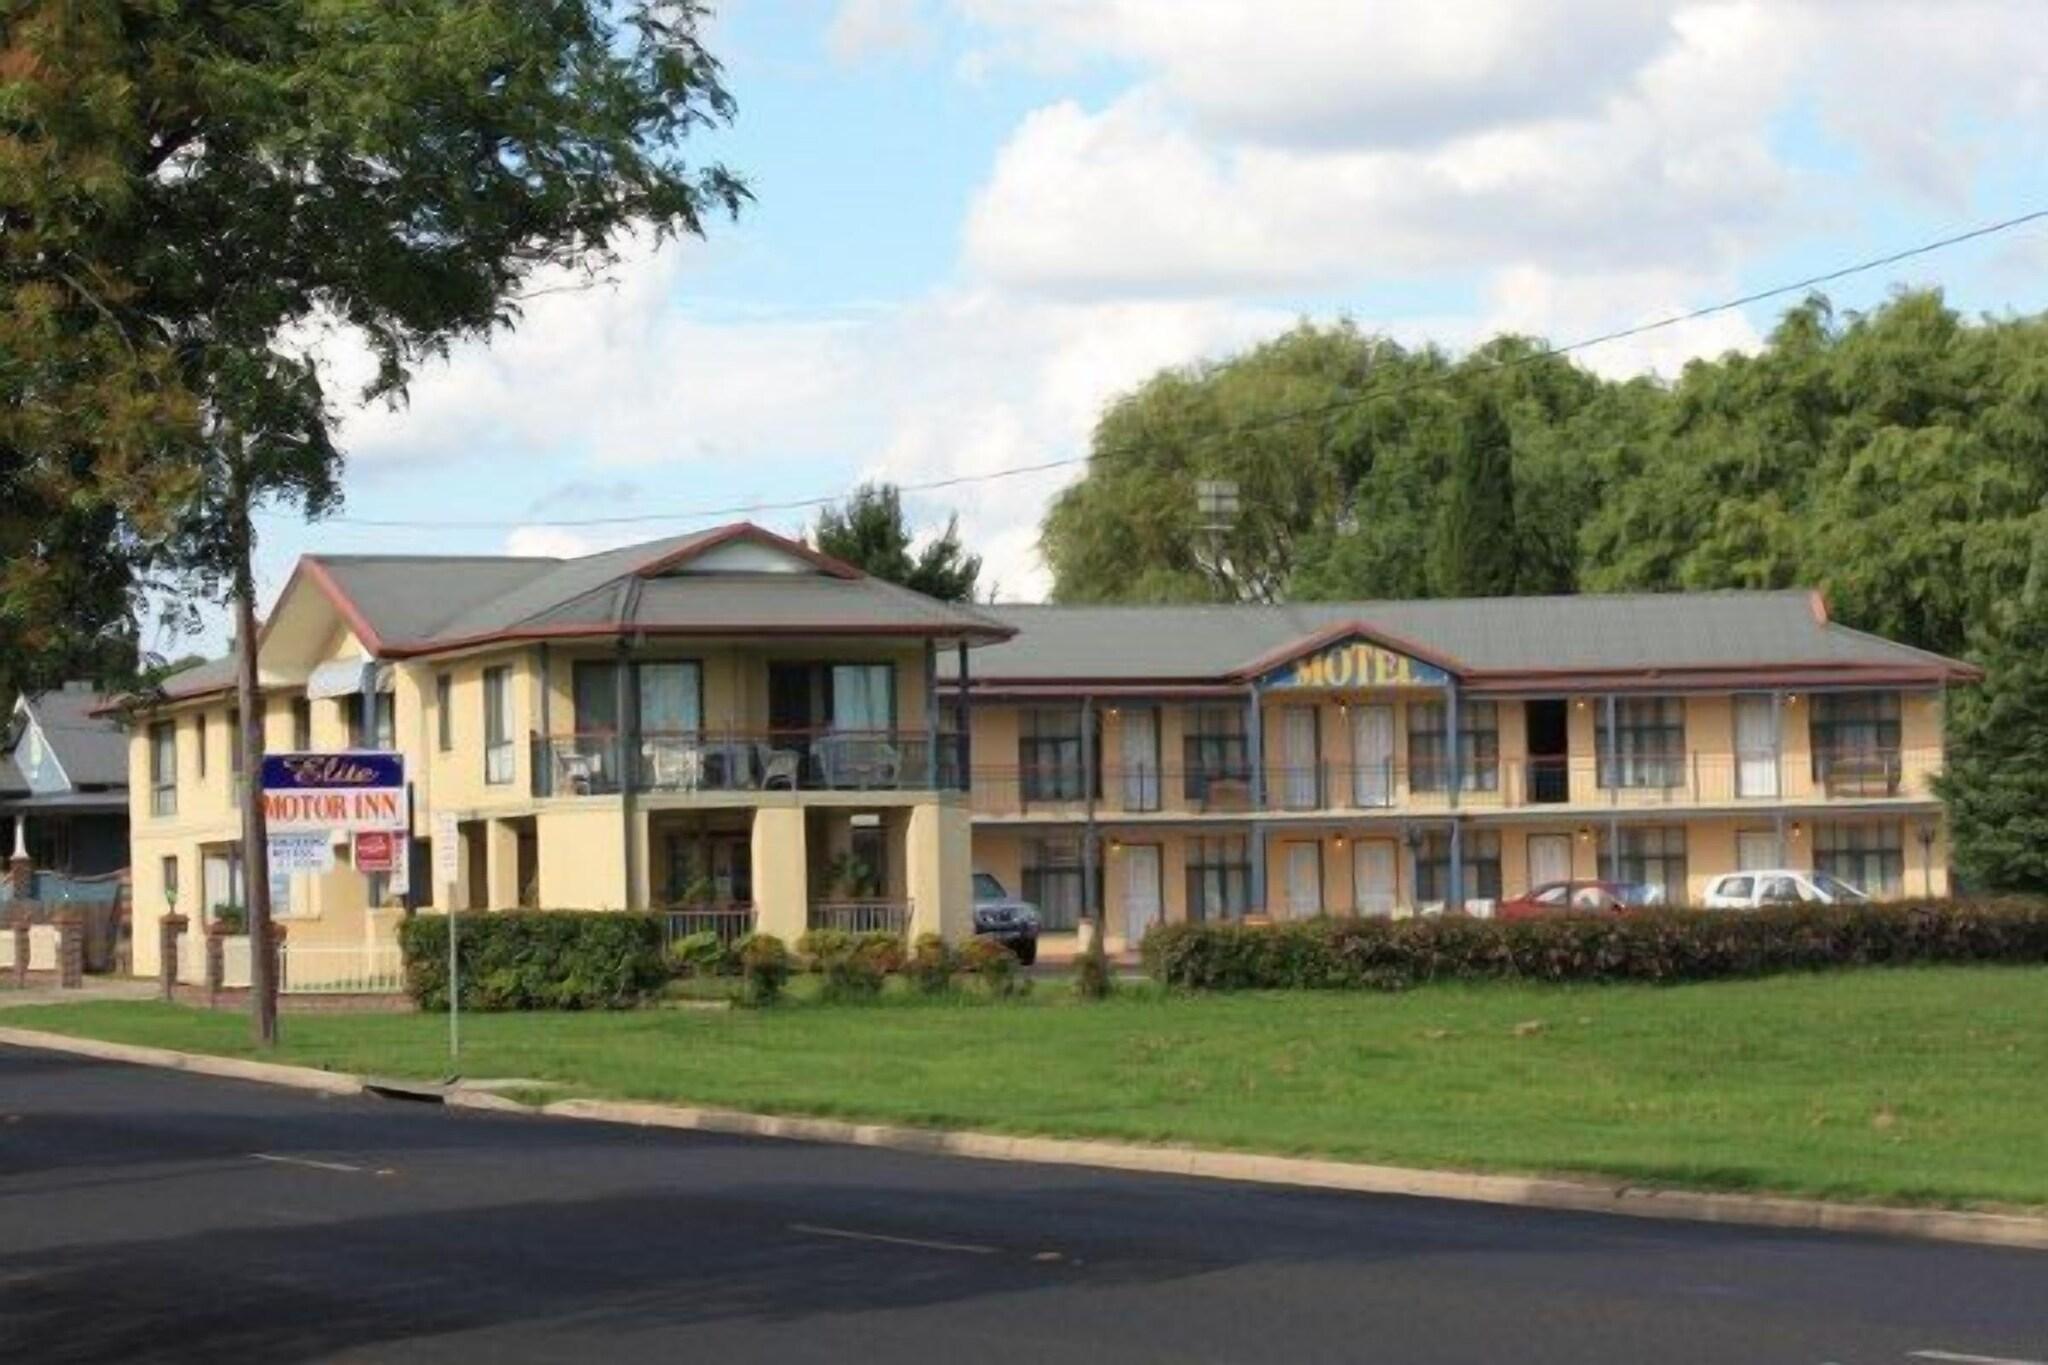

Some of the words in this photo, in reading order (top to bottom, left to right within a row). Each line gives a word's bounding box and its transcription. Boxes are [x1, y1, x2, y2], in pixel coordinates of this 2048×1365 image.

[1295, 643, 1421, 686] MOTEL
[264, 794, 348, 820] MOTOR
[354, 794, 399, 820] INN
